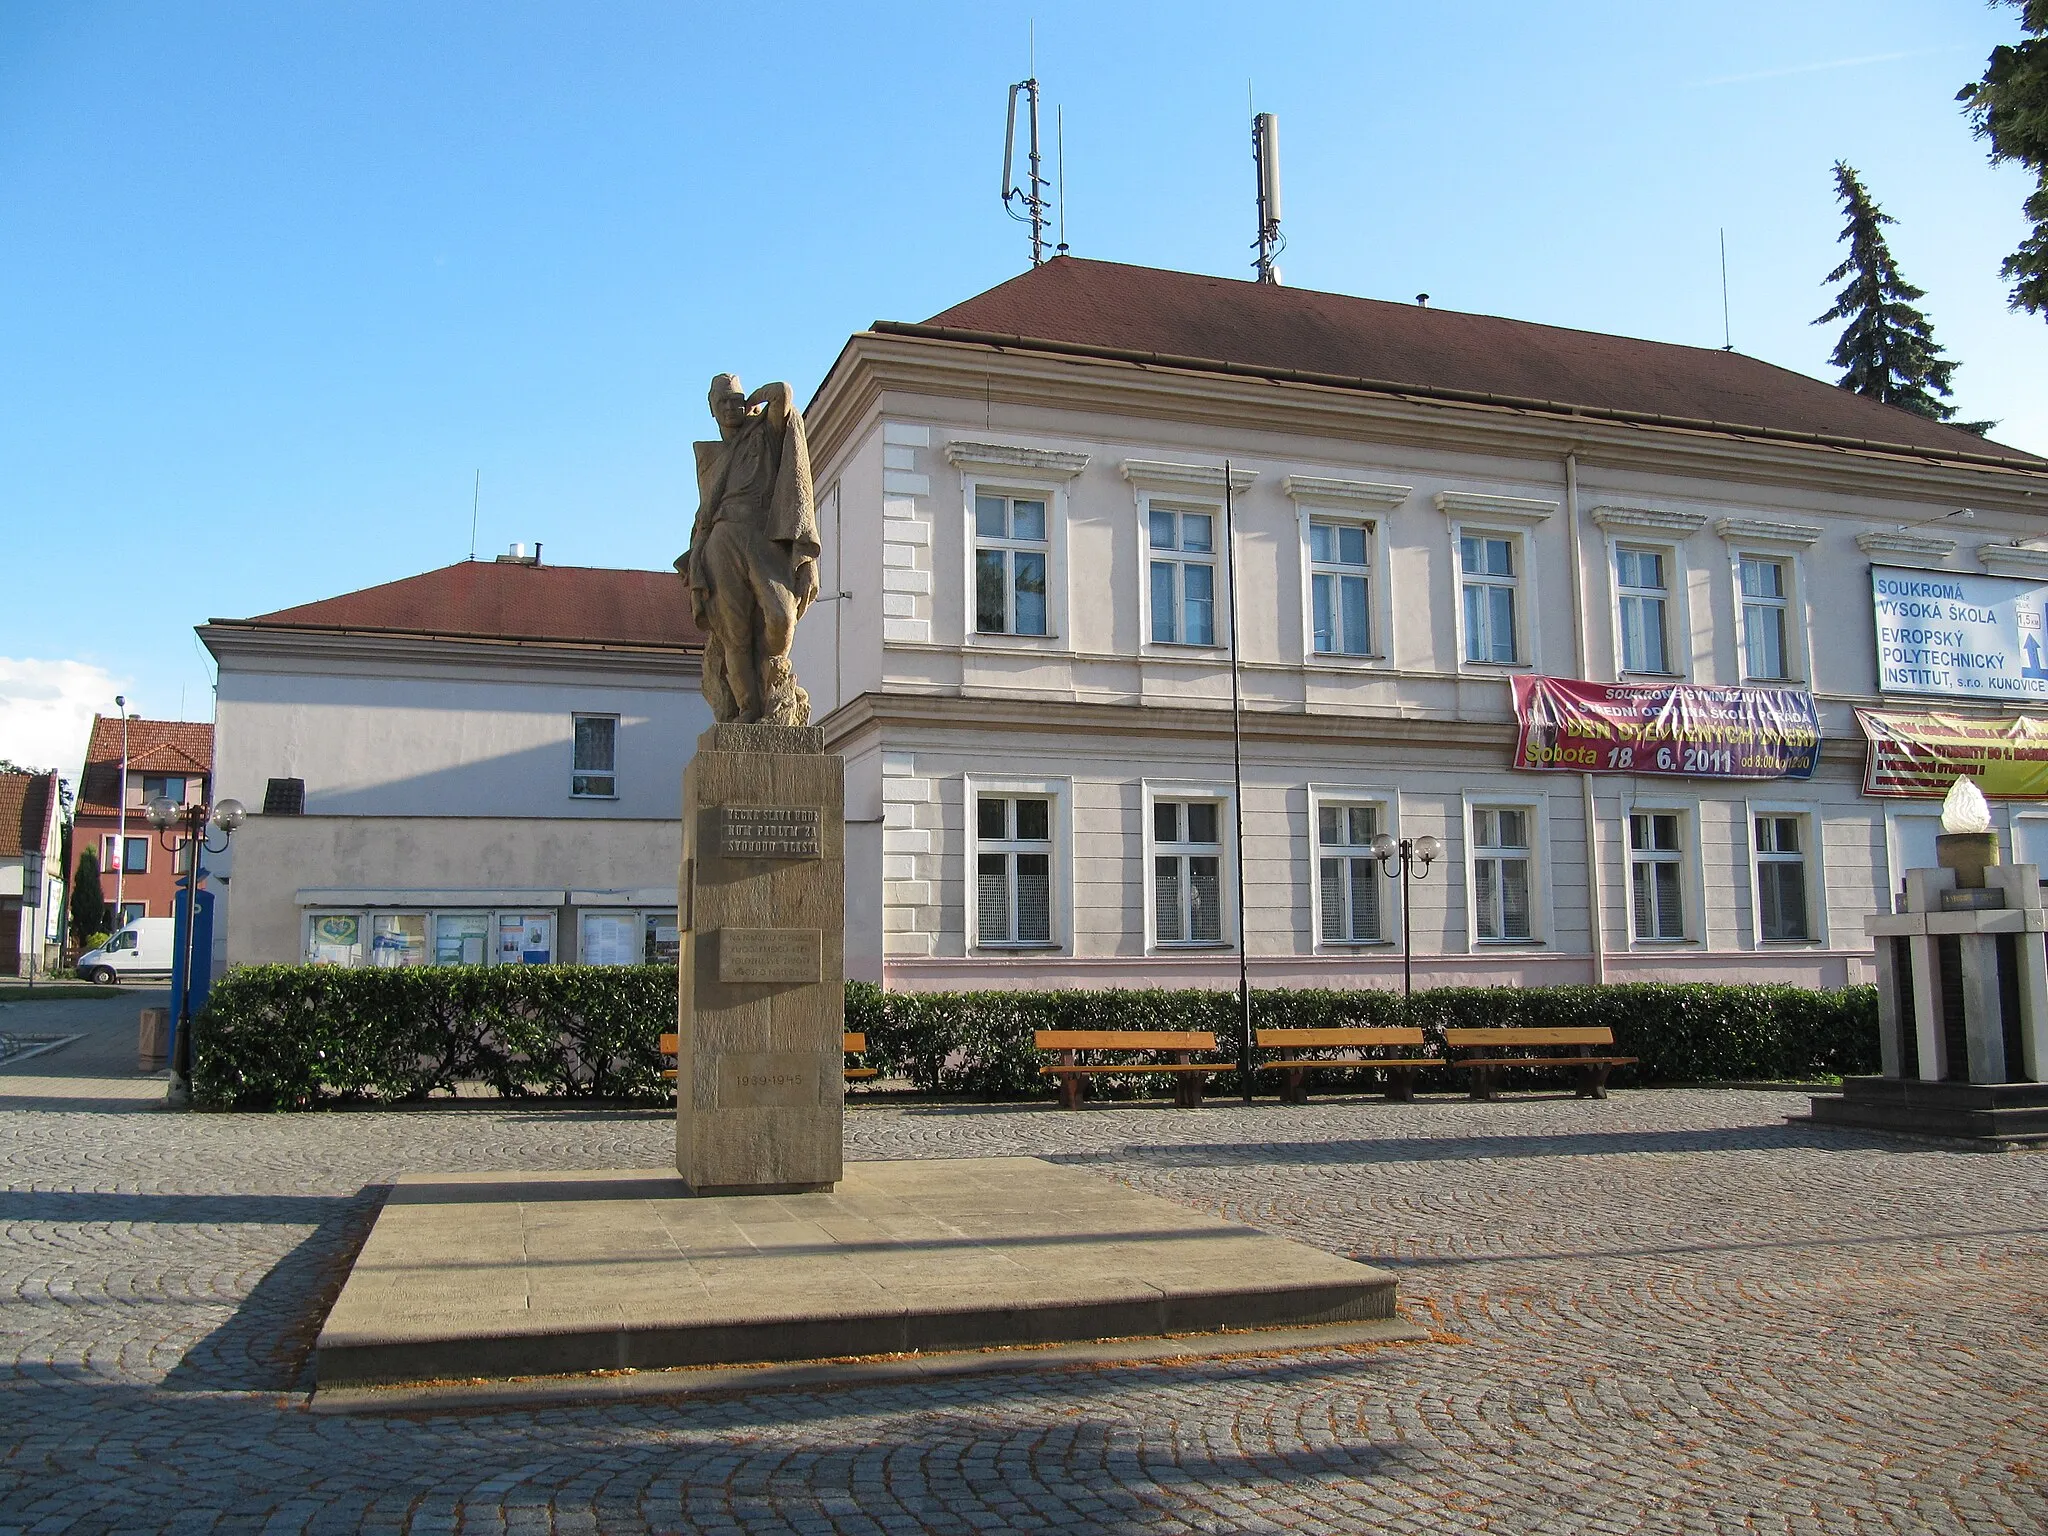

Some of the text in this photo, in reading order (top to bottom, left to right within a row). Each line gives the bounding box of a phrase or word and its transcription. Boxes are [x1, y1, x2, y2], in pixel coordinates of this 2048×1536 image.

[1878, 579, 1964, 600] SOUKROMÁ
[1881, 601, 1997, 624] VYSOKÁ ŠKOLA
[1882, 627, 1963, 647] EVROPSKÝ
[1884, 649, 2004, 669] POLYTECHNICKÝ
[1885, 668, 2046, 692] INSTITUT, s.r.o. KUNOVICE
[1710, 708, 1756, 721] ŠKOLA
[1567, 719, 1611, 739] DEN
[1525, 742, 1598, 765] Sobota
[1607, 747, 1634, 768] 18.
[1657, 749, 1676, 771] 6.
[1683, 749, 1731, 773] 2011
[1741, 756, 1752, 768] od
[1755, 755, 1774, 768] 8:00
